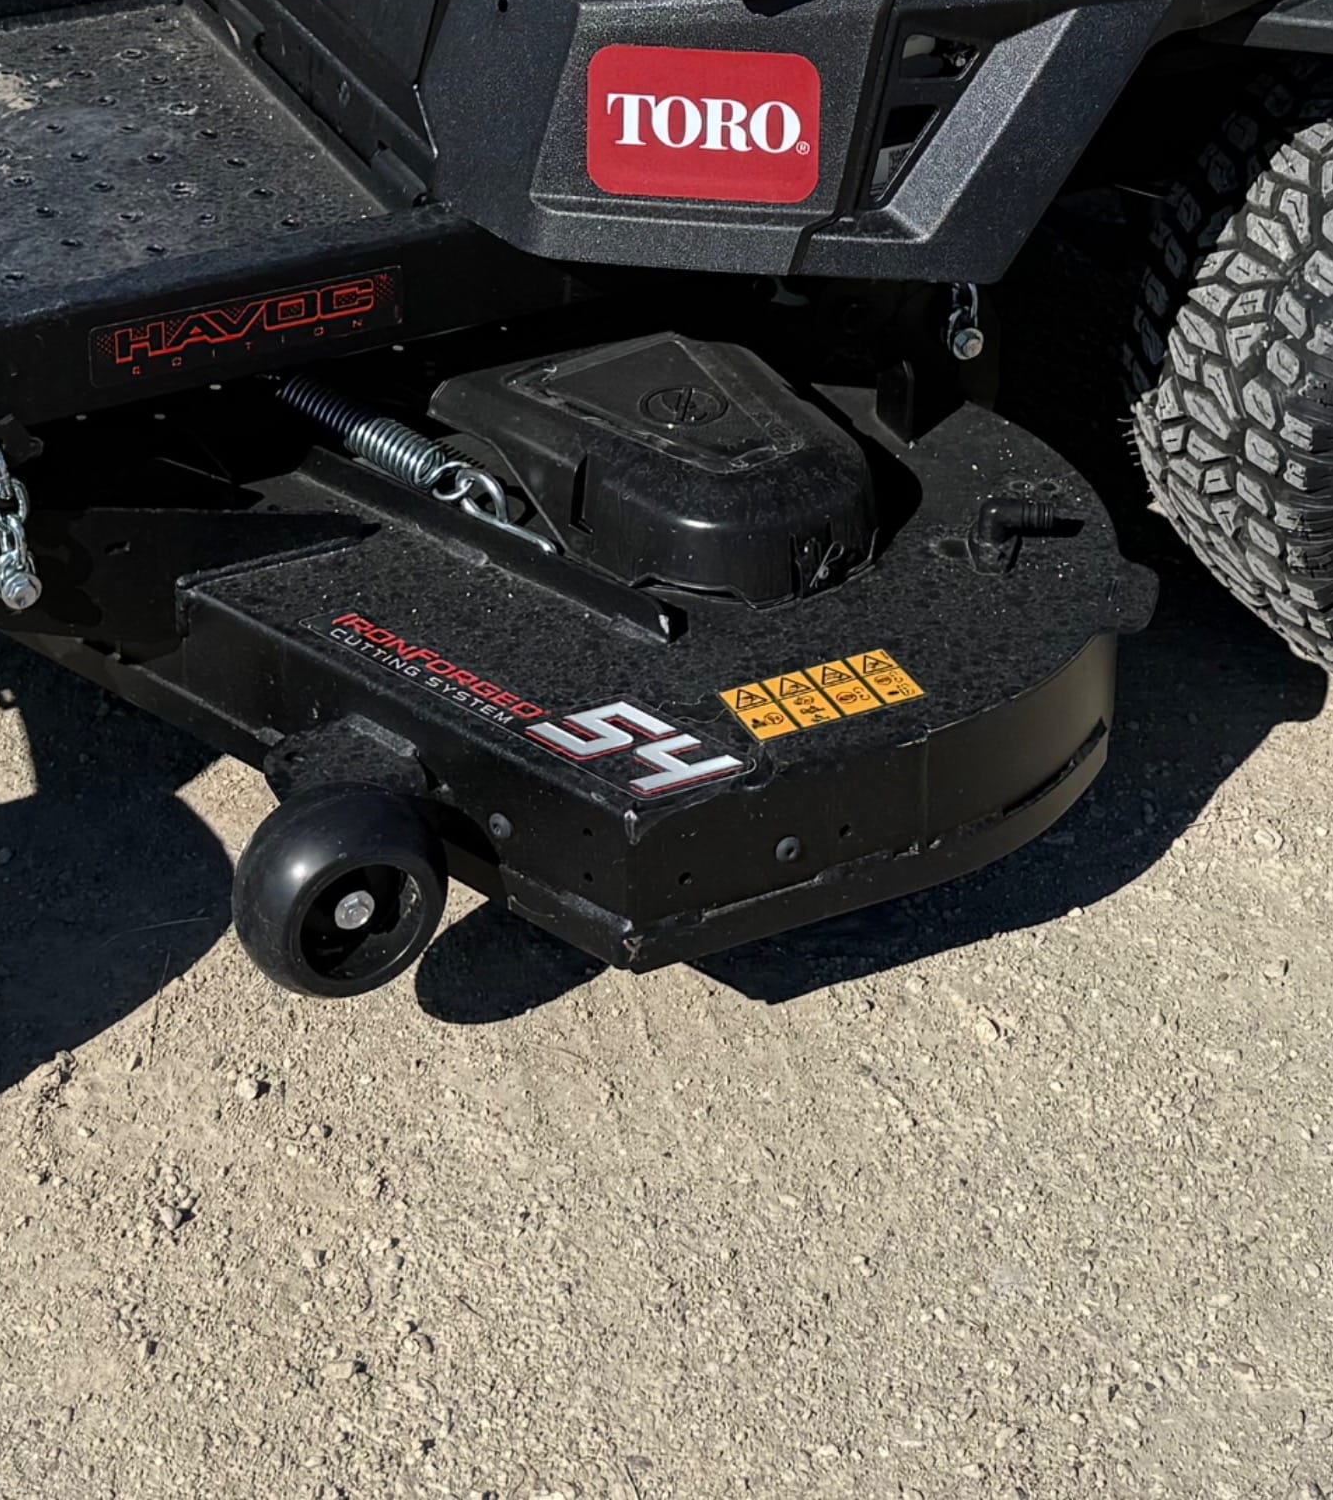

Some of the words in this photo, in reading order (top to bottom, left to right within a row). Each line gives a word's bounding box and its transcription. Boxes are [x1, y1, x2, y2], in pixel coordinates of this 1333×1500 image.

[607, 93, 802, 154] TORO
[115, 278, 374, 364] HAVOC
[330, 627, 421, 678] CUTTING
[425, 676, 515, 725] SYSTEM
[332, 612, 545, 719] IRONFORGED
[525, 701, 744, 795] 54
